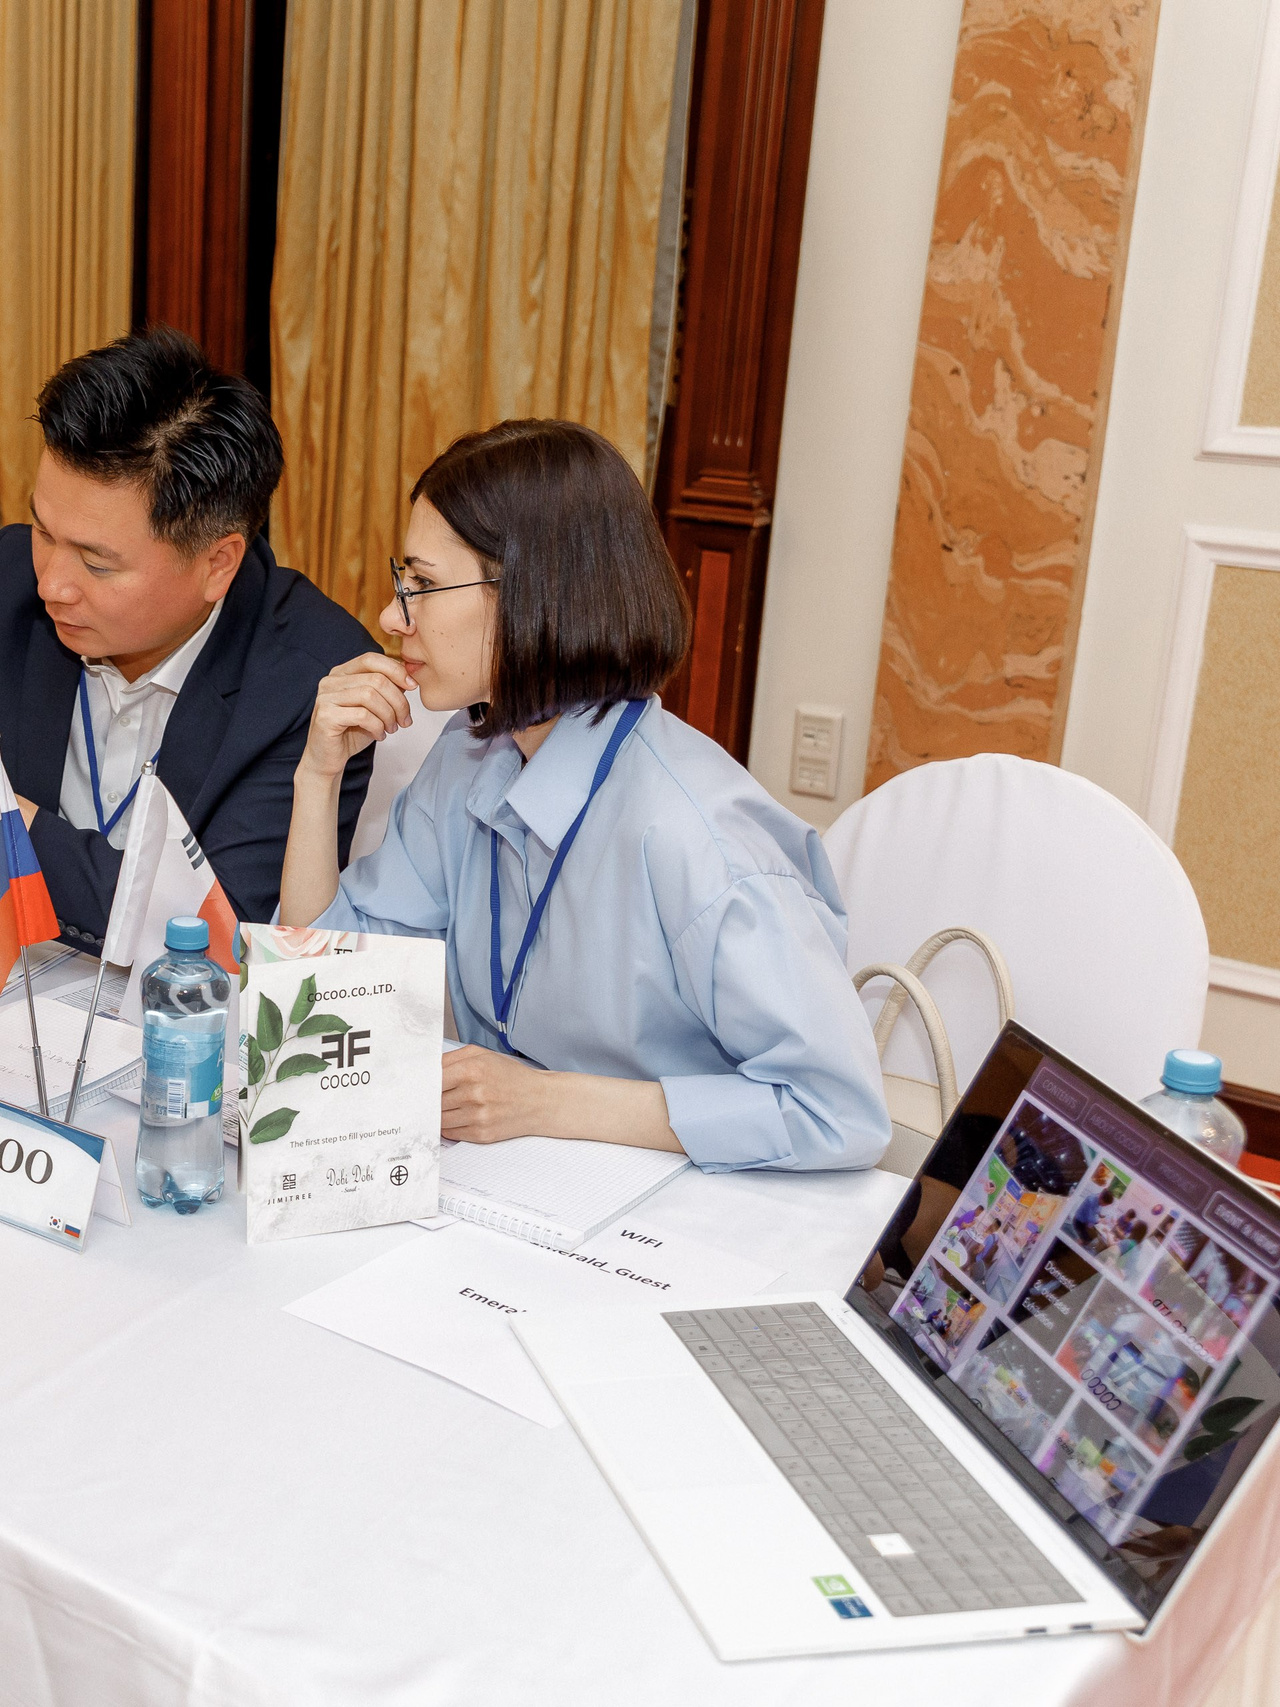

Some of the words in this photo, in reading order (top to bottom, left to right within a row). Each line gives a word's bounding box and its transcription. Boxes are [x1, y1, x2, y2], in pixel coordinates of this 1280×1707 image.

[320, 1070, 371, 1090] COCOO
[305, 1138, 320, 1147] first
[321, 1136, 338, 1146] step
[339, 1134, 347, 1142] to
[348, 1132, 358, 1140] fill
[359, 1131, 376, 1140] your
[378, 1127, 401, 1138] beuty!
[326, 1167, 348, 1187] Dobi
[351, 1164, 374, 1183] Dobi
[267, 1192, 312, 1205] JIMITREE
[620, 1229, 663, 1248] WIFI
